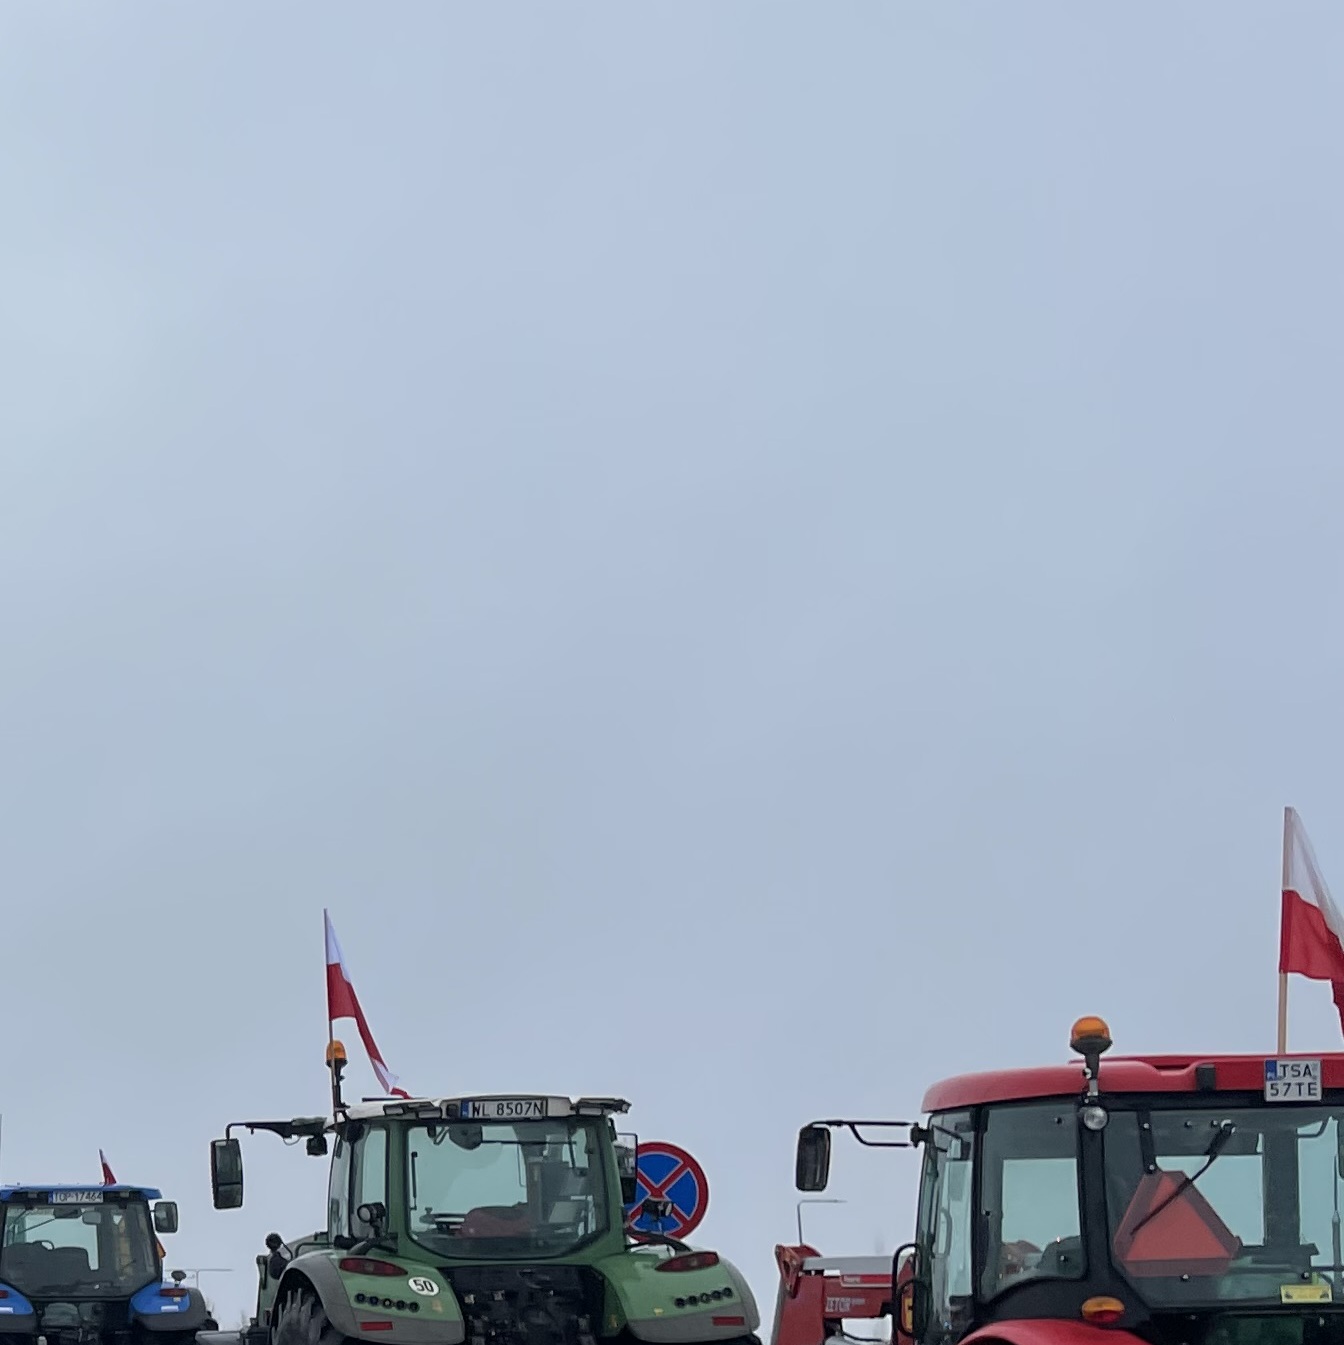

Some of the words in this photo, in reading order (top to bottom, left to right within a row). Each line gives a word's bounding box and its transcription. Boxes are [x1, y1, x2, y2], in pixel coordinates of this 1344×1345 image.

[1279, 1063, 1312, 1078] TSA
[1270, 1082, 1317, 1097] 57TE
[472, 1101, 490, 1117] WL
[496, 1101, 544, 1116] 8507N
[413, 1279, 434, 1293] 50
